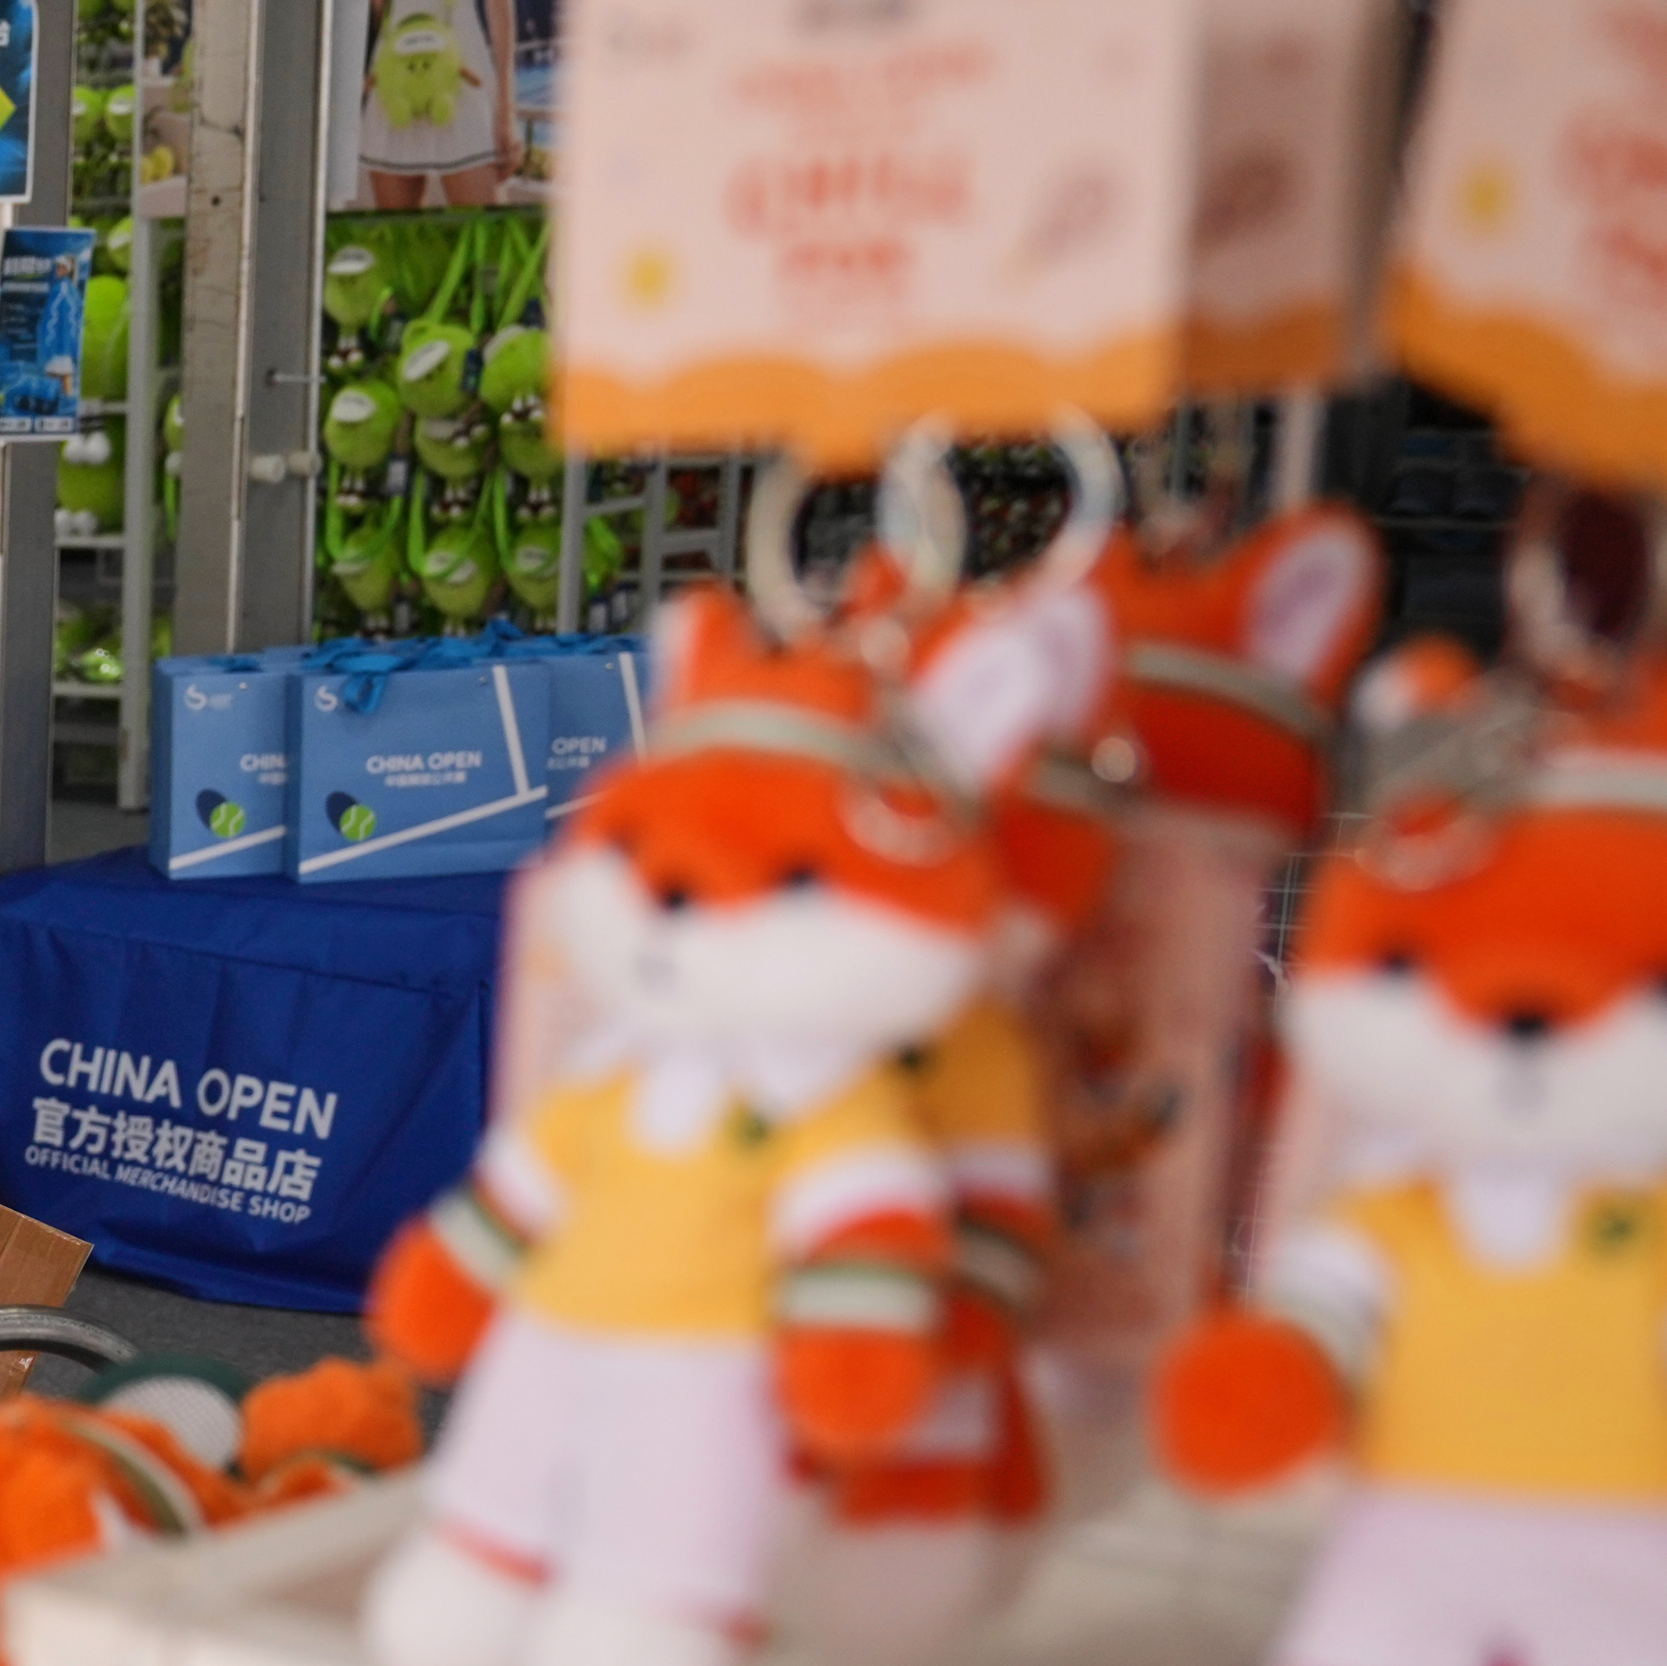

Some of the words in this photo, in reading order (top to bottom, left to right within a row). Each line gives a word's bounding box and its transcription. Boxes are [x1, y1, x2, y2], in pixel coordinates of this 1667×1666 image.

[366, 754, 424, 774] CHINA
[428, 750, 482, 771] OPEN
[552, 737, 605, 755] OPEN
[39, 1038, 181, 1109] CHINA
[197, 1067, 338, 1140] OPEN
[24, 1146, 112, 1180] OFFICIAL
[114, 1162, 243, 1211] MERCHANDISE
[248, 1196, 312, 1224] SHOP
[32, 1096, 322, 1201] 官方授权商品店
